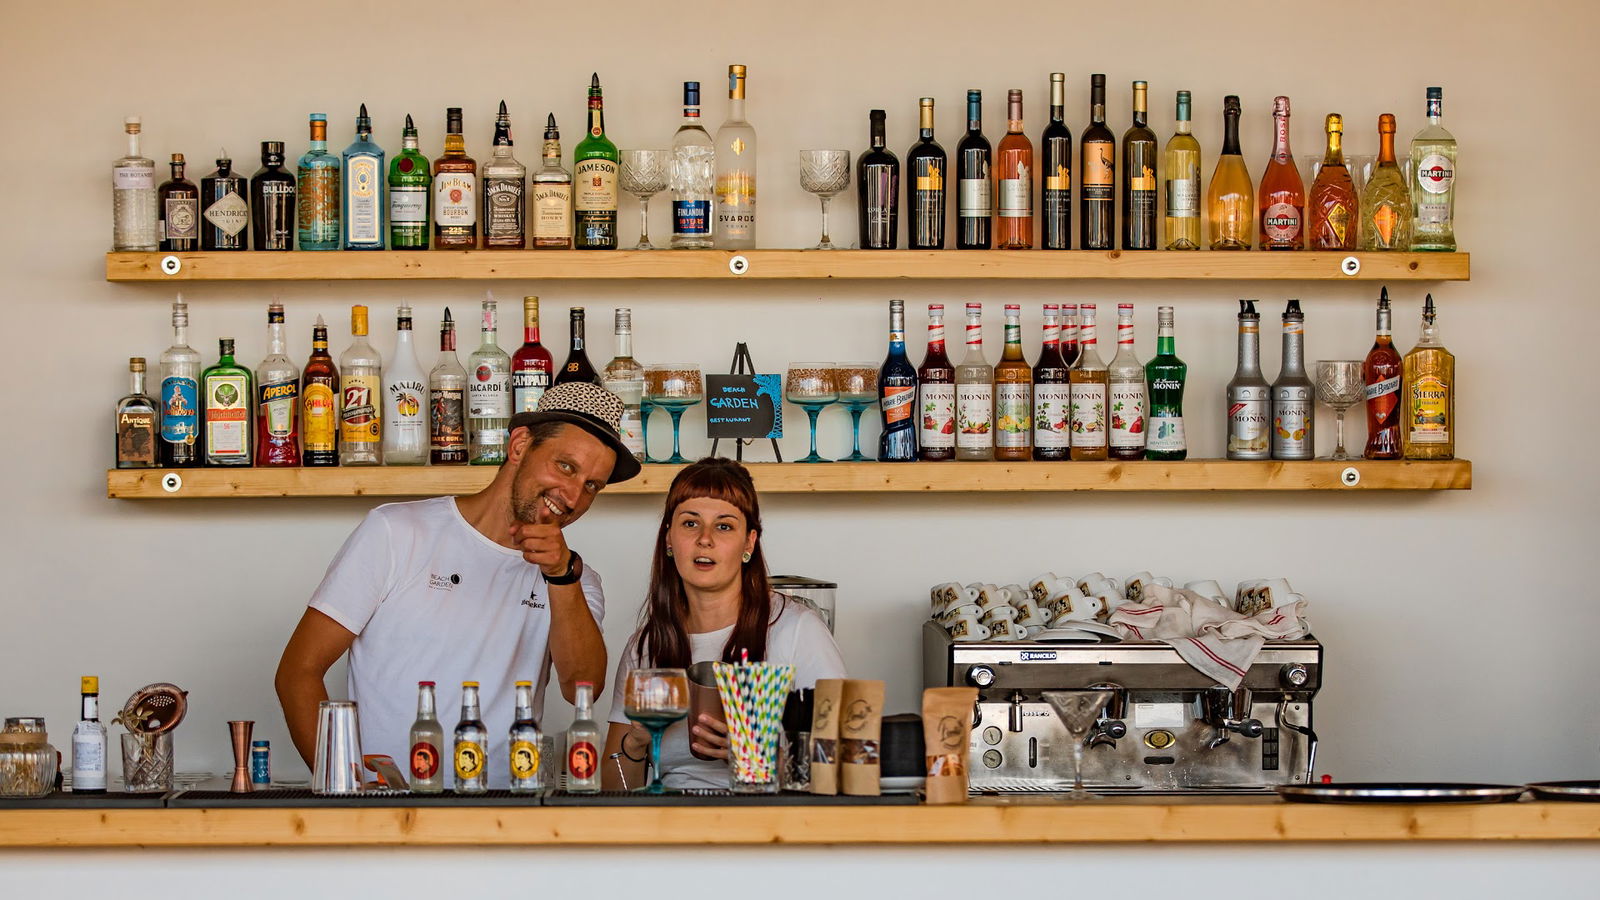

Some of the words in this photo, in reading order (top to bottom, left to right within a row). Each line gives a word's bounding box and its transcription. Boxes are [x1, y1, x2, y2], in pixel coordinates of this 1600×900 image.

[578, 163, 615, 174] JAMESON
[453, 178, 472, 192] BEAM
[487, 185, 500, 196] JACK
[678, 208, 704, 216] FINLANDIA
[513, 376, 548, 386] CAMPARI
[264, 384, 296, 400] APEROL
[390, 382, 425, 395] MALIBU
[1413, 389, 1445, 399] SIERRA
[346, 389, 368, 409] 21
[710, 398, 759, 408] GARDEN
